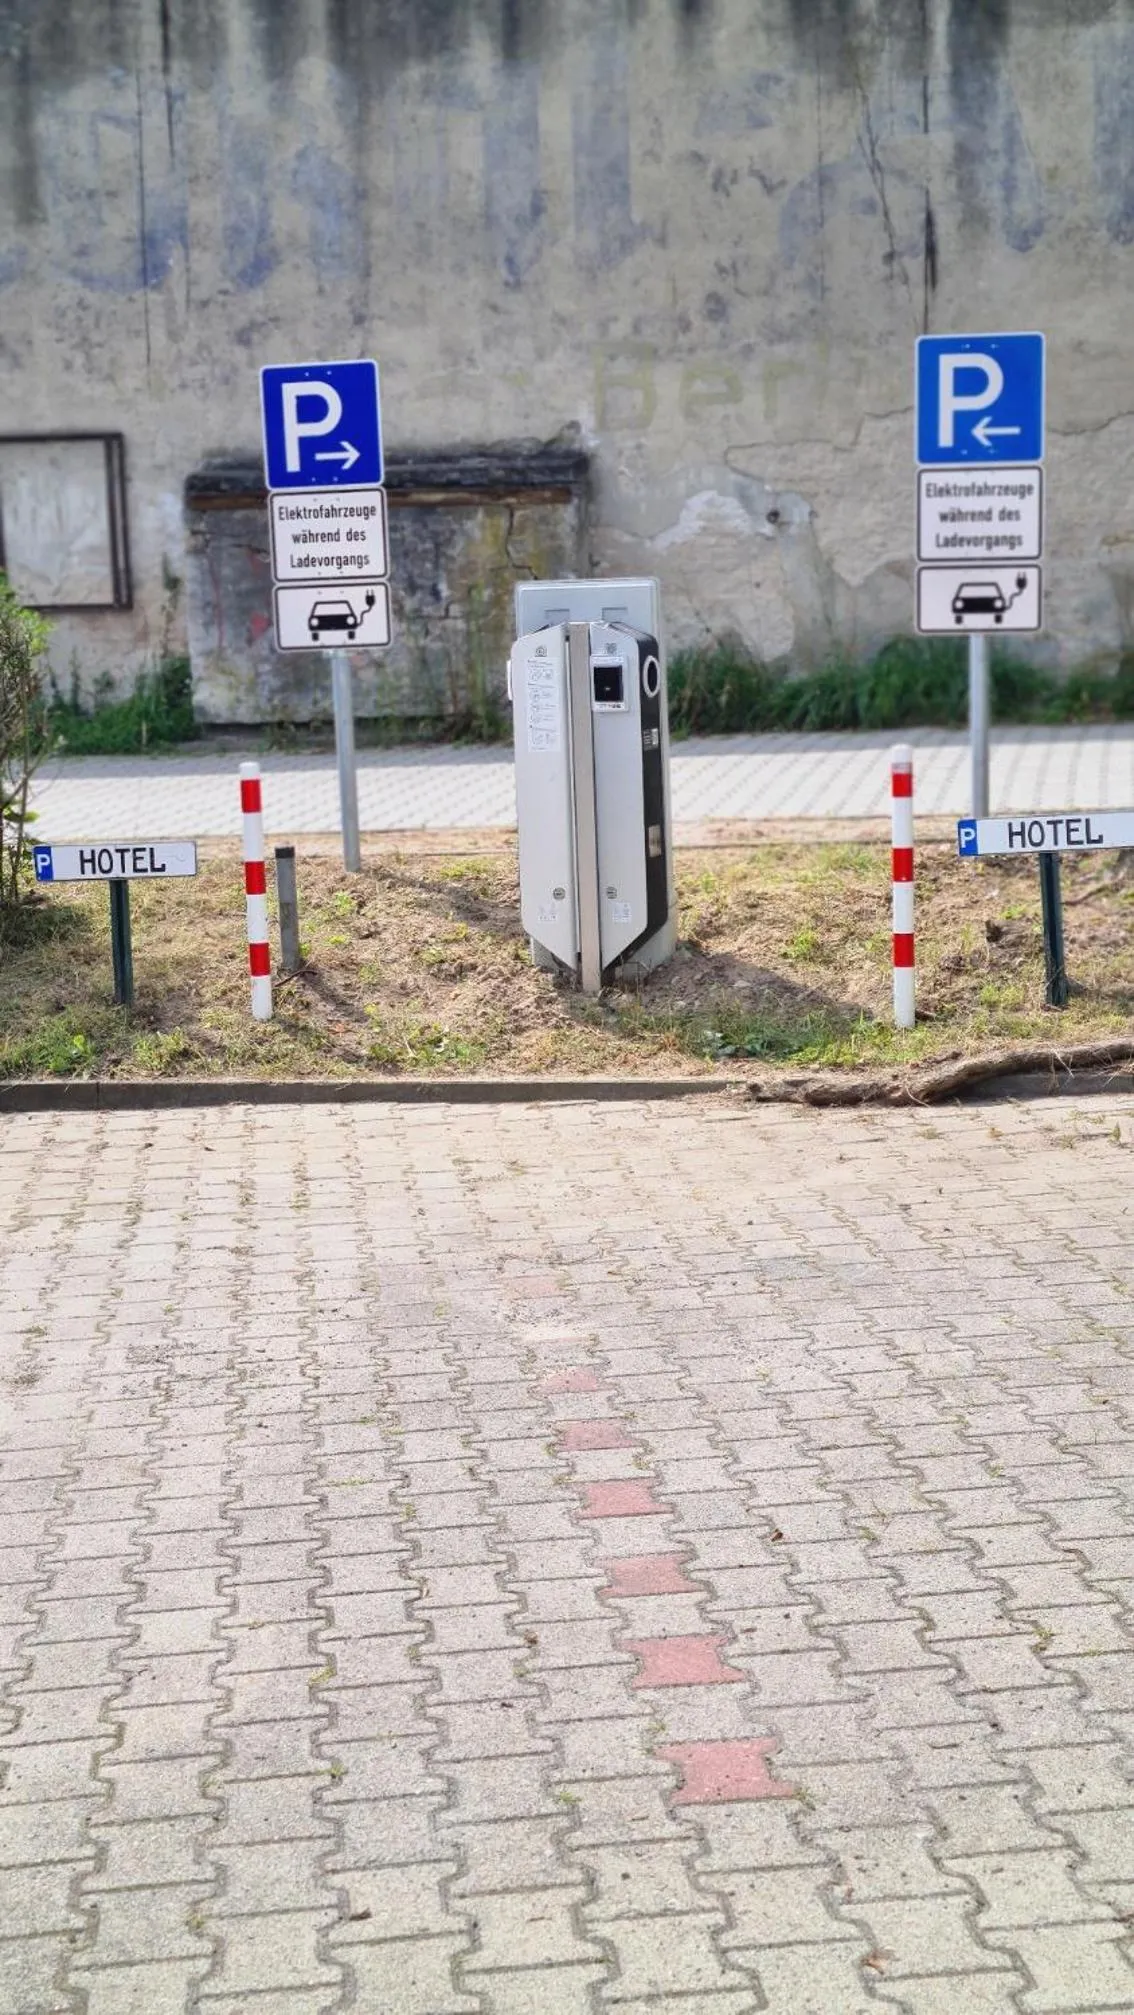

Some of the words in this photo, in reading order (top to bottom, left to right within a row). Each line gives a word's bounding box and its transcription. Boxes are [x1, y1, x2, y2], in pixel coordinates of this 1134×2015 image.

[938, 353, 1004, 448] P
[281, 381, 343, 473] P
[925, 482, 1035, 500] Elektrofahrzeuge
[278, 503, 377, 521] Elektrofahrzeuge
[939, 507, 993, 523] während
[998, 506, 1021, 522] des
[292, 528, 341, 545] während
[346, 527, 367, 542] des
[935, 532, 1024, 550] Ladevorgangs
[290, 552, 371, 570] Ladevorgangs
[960, 828, 976, 849] P
[1008, 818, 1104, 849] HOTEL
[37, 854, 50, 874] P
[79, 847, 166, 875] HOTEL
